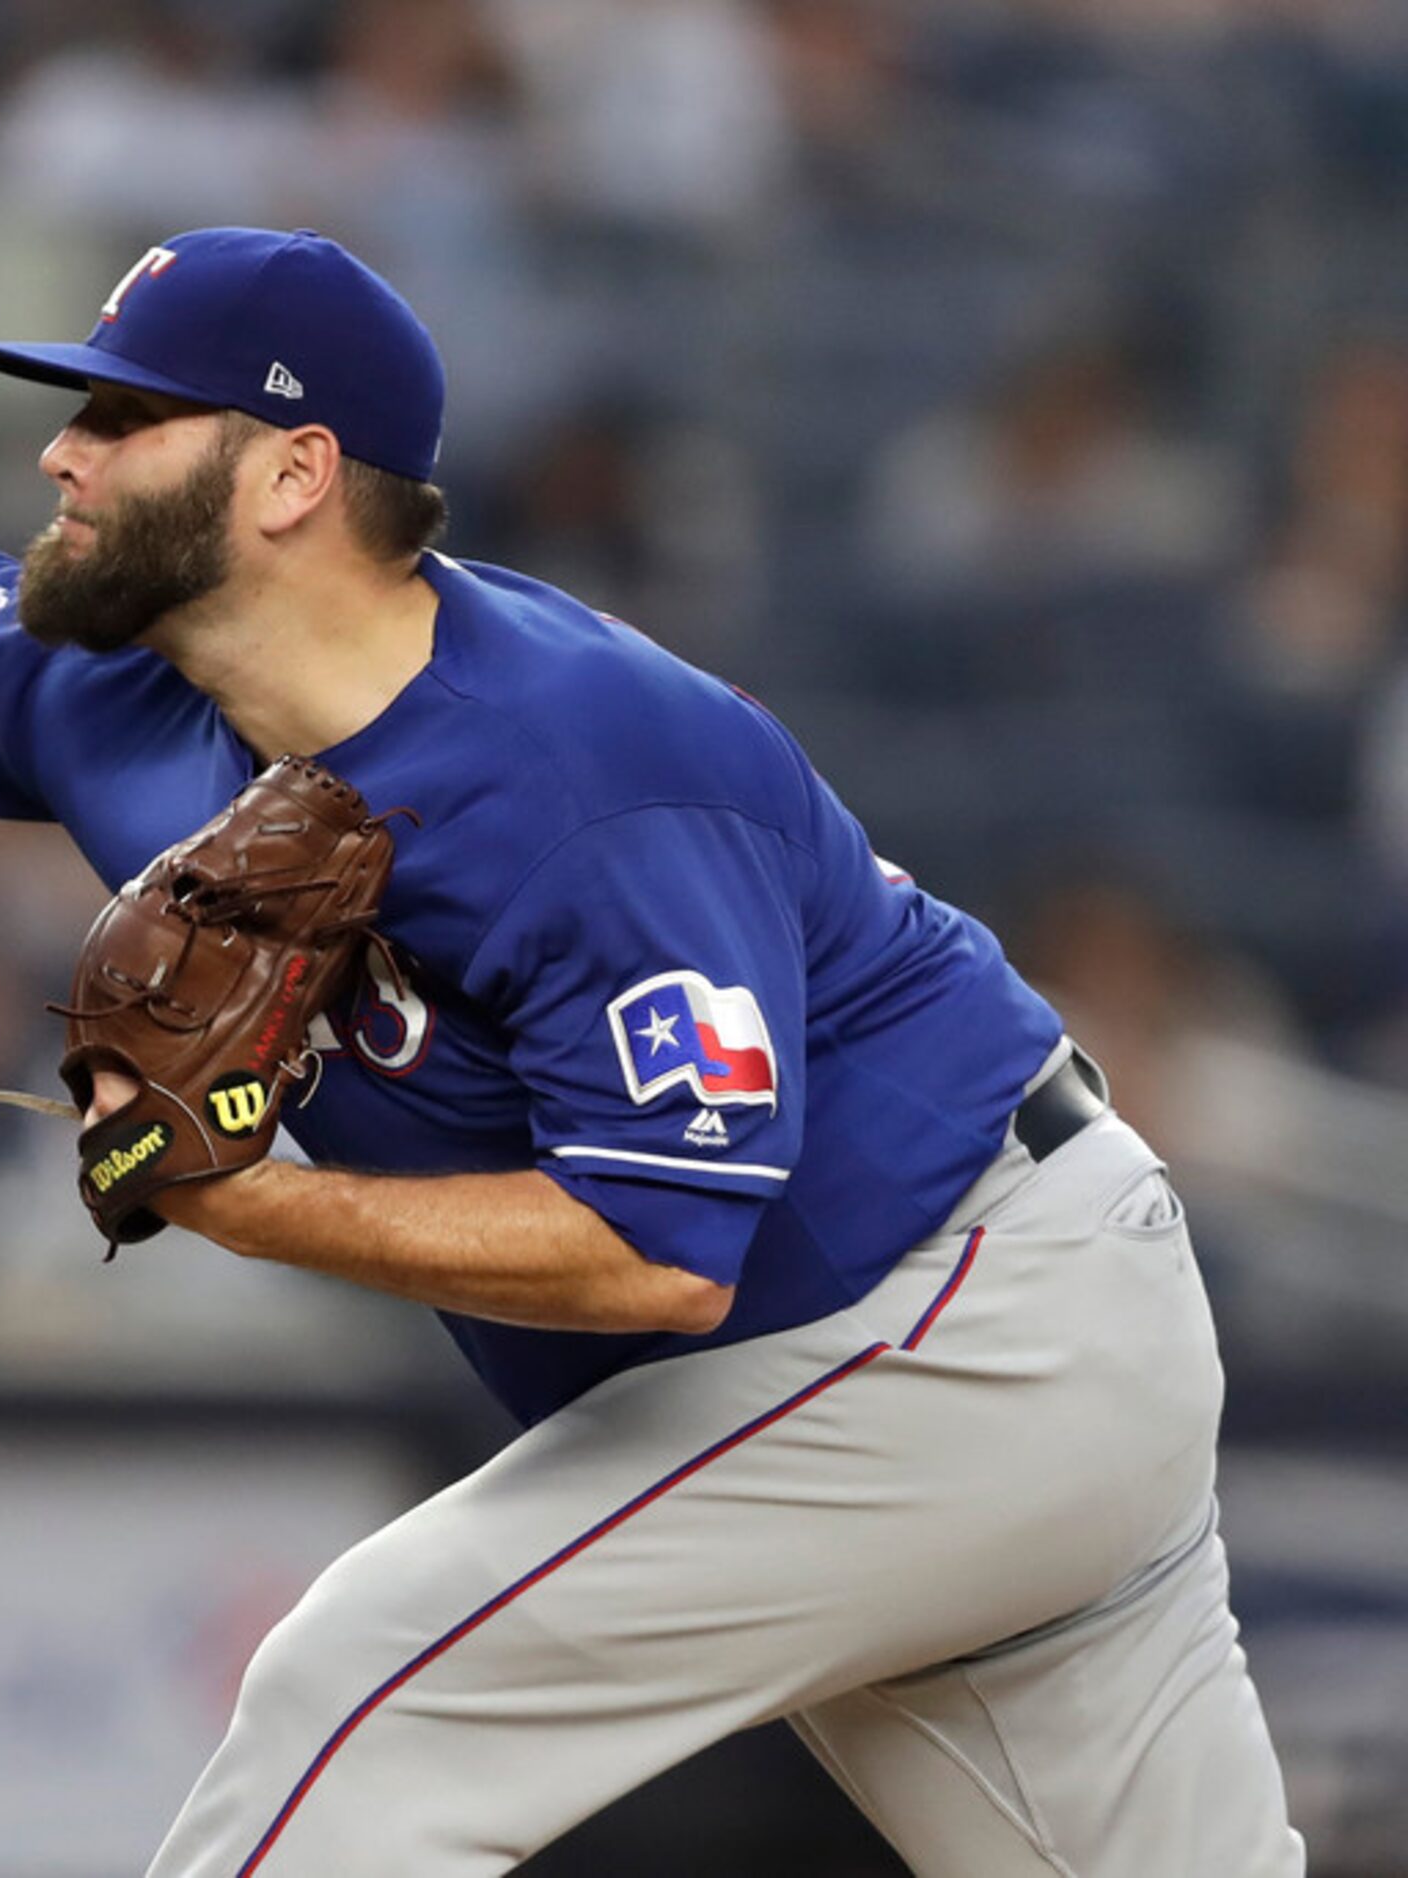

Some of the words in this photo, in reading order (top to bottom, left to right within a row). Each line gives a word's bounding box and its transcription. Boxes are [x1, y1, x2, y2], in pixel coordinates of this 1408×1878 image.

[101, 247, 177, 322] T
[208, 1080, 266, 1133] W
[90, 1126, 166, 1193] Wilson
